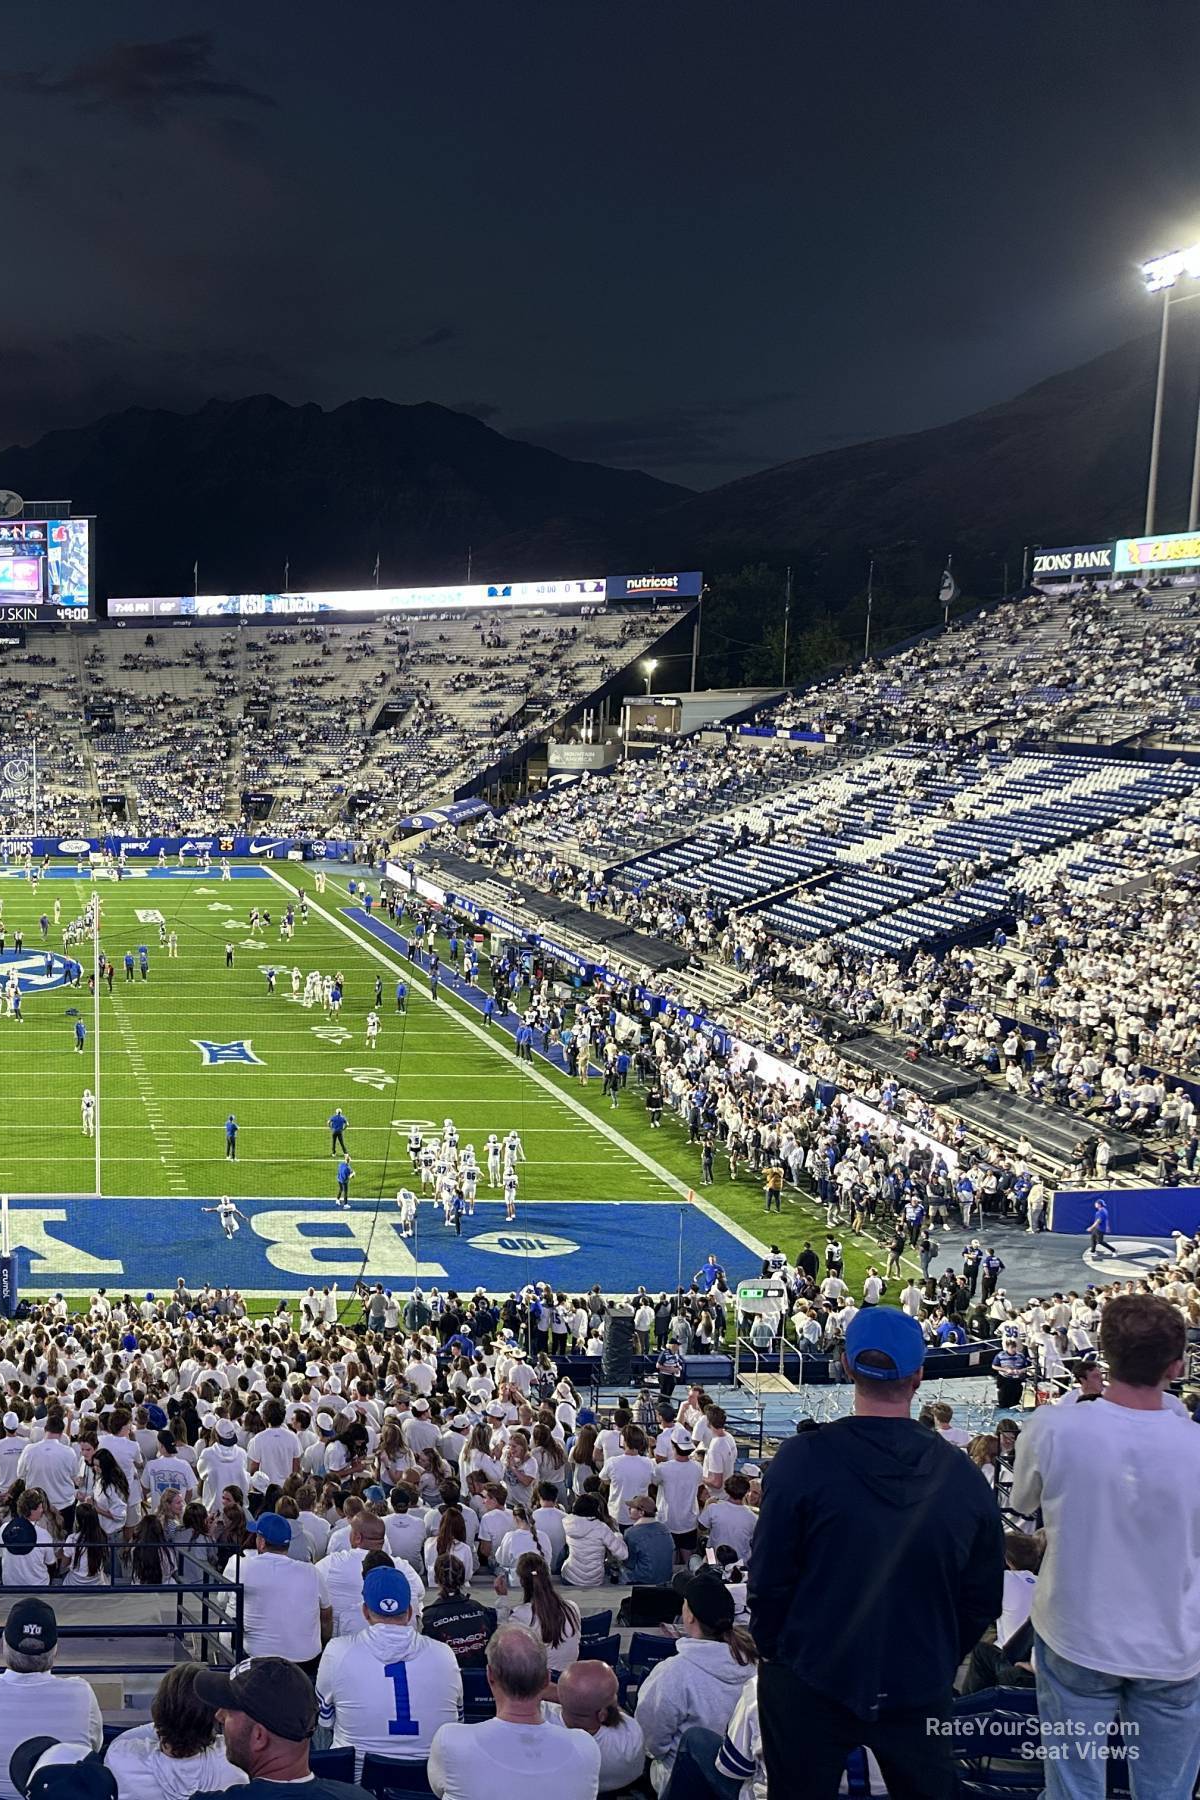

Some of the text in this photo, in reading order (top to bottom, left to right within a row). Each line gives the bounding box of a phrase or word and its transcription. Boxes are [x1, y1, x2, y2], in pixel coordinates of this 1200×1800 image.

[1033, 549, 1112, 572] ZIONS BANK
[626, 576, 678, 588] nutricost
[7, 608, 37, 620] SKIN
[56, 607, 89, 619] 49:00
[220, 841, 233, 851] 25
[433, 1615, 460, 1627] CEDAR
[23, 1624, 42, 1635] BYU
[453, 1640, 488, 1655] EGIMENT
[384, 1661, 419, 1735] 1
